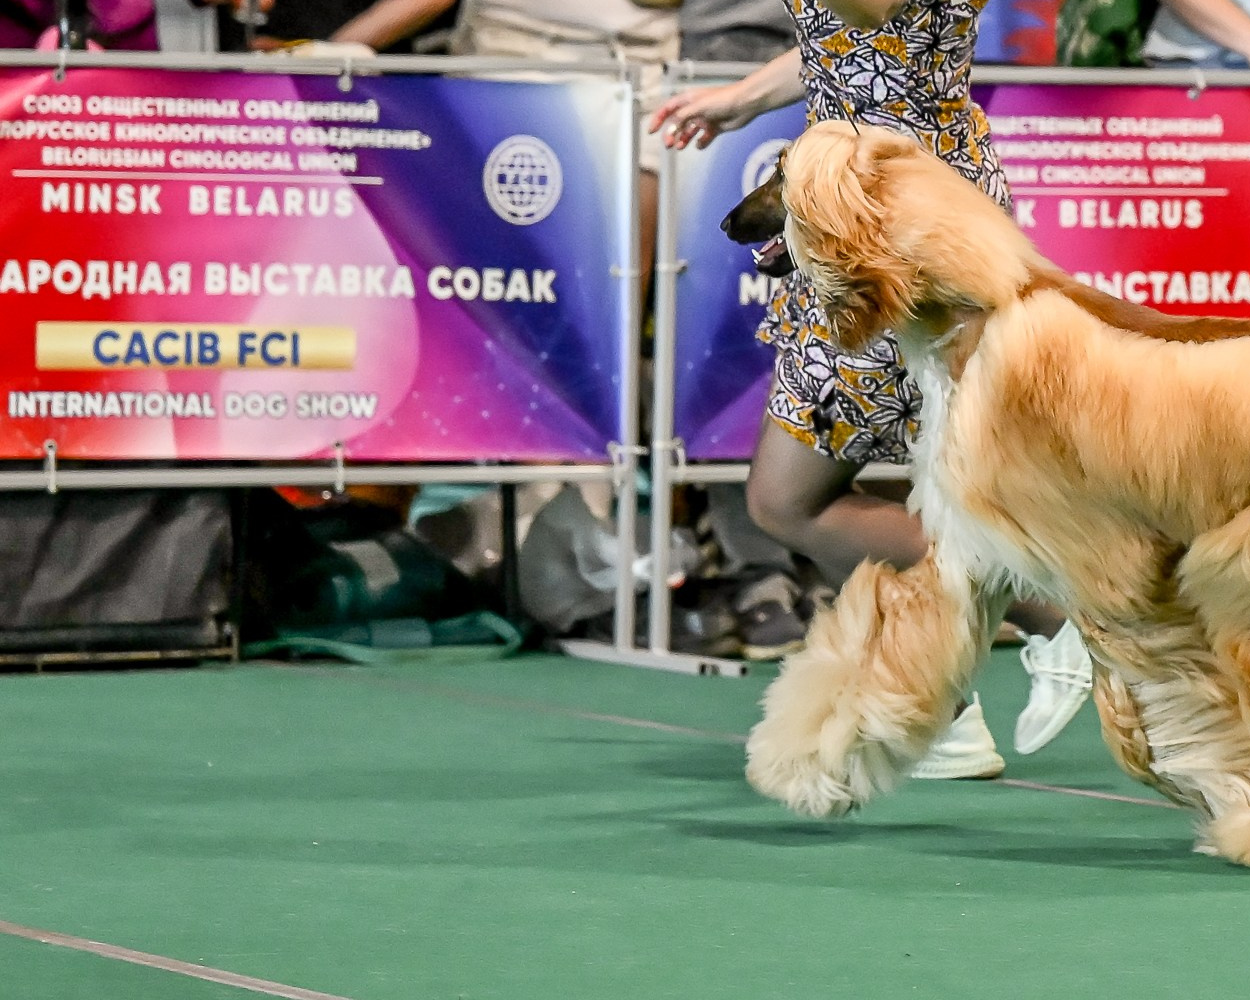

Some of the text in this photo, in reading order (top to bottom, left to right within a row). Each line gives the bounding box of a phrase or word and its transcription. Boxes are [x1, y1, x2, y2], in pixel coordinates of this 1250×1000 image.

[42, 182, 354, 218] MINSK BELARUS
[1059, 199, 1205, 229] BELARUS
[204, 262, 415, 299] ВЫСТАВКА
[427, 265, 557, 304] СОБАК
[92, 330, 300, 367] CACIB FCI
[8, 391, 378, 420] INTERNATIONAL DOG SHOW
